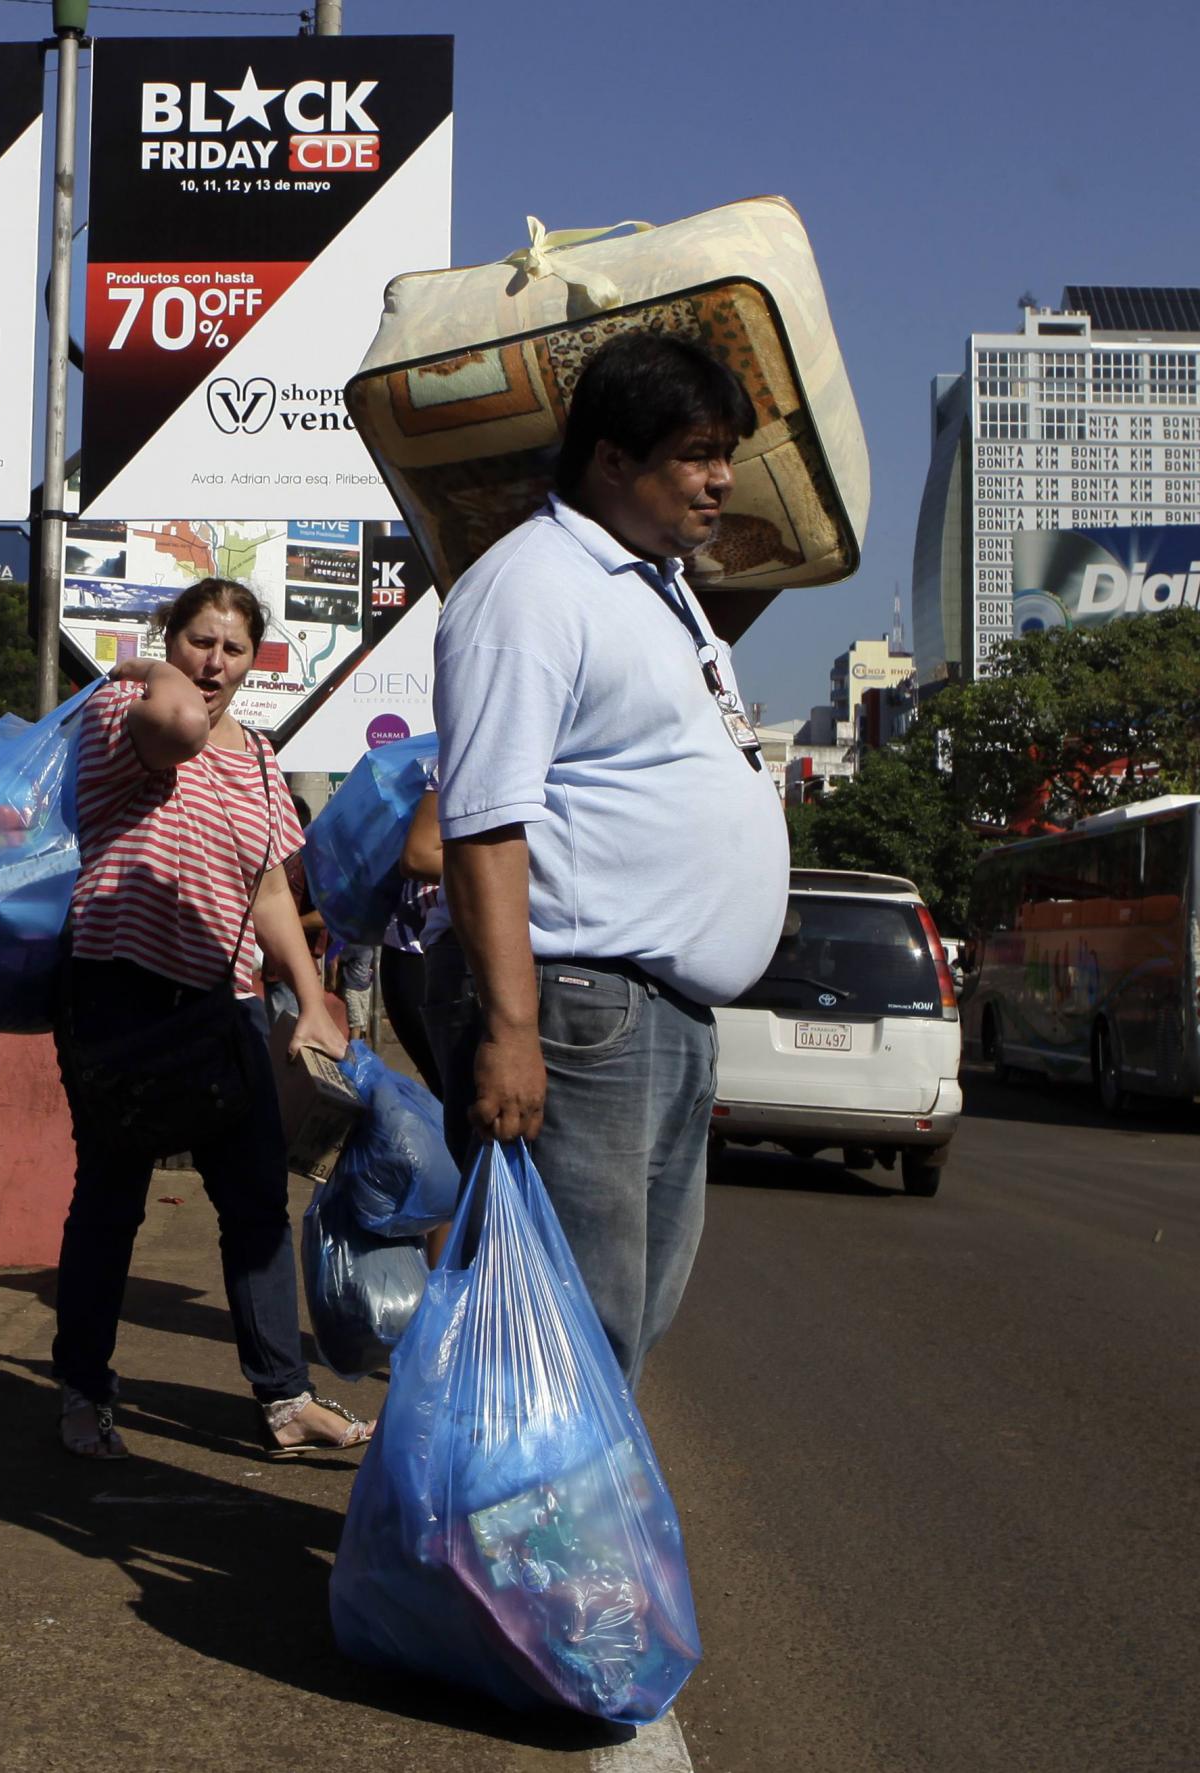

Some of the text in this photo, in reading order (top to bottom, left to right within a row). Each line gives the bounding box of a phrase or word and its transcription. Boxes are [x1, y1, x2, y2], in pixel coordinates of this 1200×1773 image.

[141, 139, 373, 169] FRIDAY CDE
[180, 180, 331, 194] 10, 11, 12 y 13 de mayo
[106, 271, 254, 284] Productos con hasta
[107, 287, 197, 350] 70
[199, 288, 263, 316] OFF
[1130, 417, 1152, 427] KIM
[1130, 429, 1152, 440] KIM
[978, 446, 1023, 456] BONITA
[1036, 447, 1058, 457] KIM
[1072, 447, 1118, 458] BONITA
[1130, 448, 1152, 458] KIM
[978, 458, 1023, 468] BONITA
[1036, 459, 1058, 469] KIM
[1072, 459, 1118, 470] BONITA
[1130, 460, 1152, 470] KIM
[192, 473, 226, 485] Avda.
[231, 472, 270, 484] Adrian
[273, 473, 302, 485] Jara
[305, 476, 331, 488] esq.
[978, 477, 1023, 487] BONITA
[1036, 478, 1058, 488] KIM
[1072, 478, 1118, 489] BONITA
[1130, 479, 1152, 489] KIM
[978, 489, 1023, 499] BONITA
[1036, 490, 1058, 500] KIM
[1072, 490, 1118, 501] BONITA
[1130, 491, 1152, 501] KIM
[978, 508, 1023, 518] BONITA
[1036, 509, 1058, 519] KIM
[1072, 509, 1118, 520] BONITA
[1130, 510, 1152, 520] KIM
[979, 520, 1059, 530] BONITA KIM
[257, 681, 305, 692] FRONTERA
[354, 672, 427, 694] DIEN
[912, 1002, 933, 1010] NOAH
[826, 1034, 846, 1047] 497
